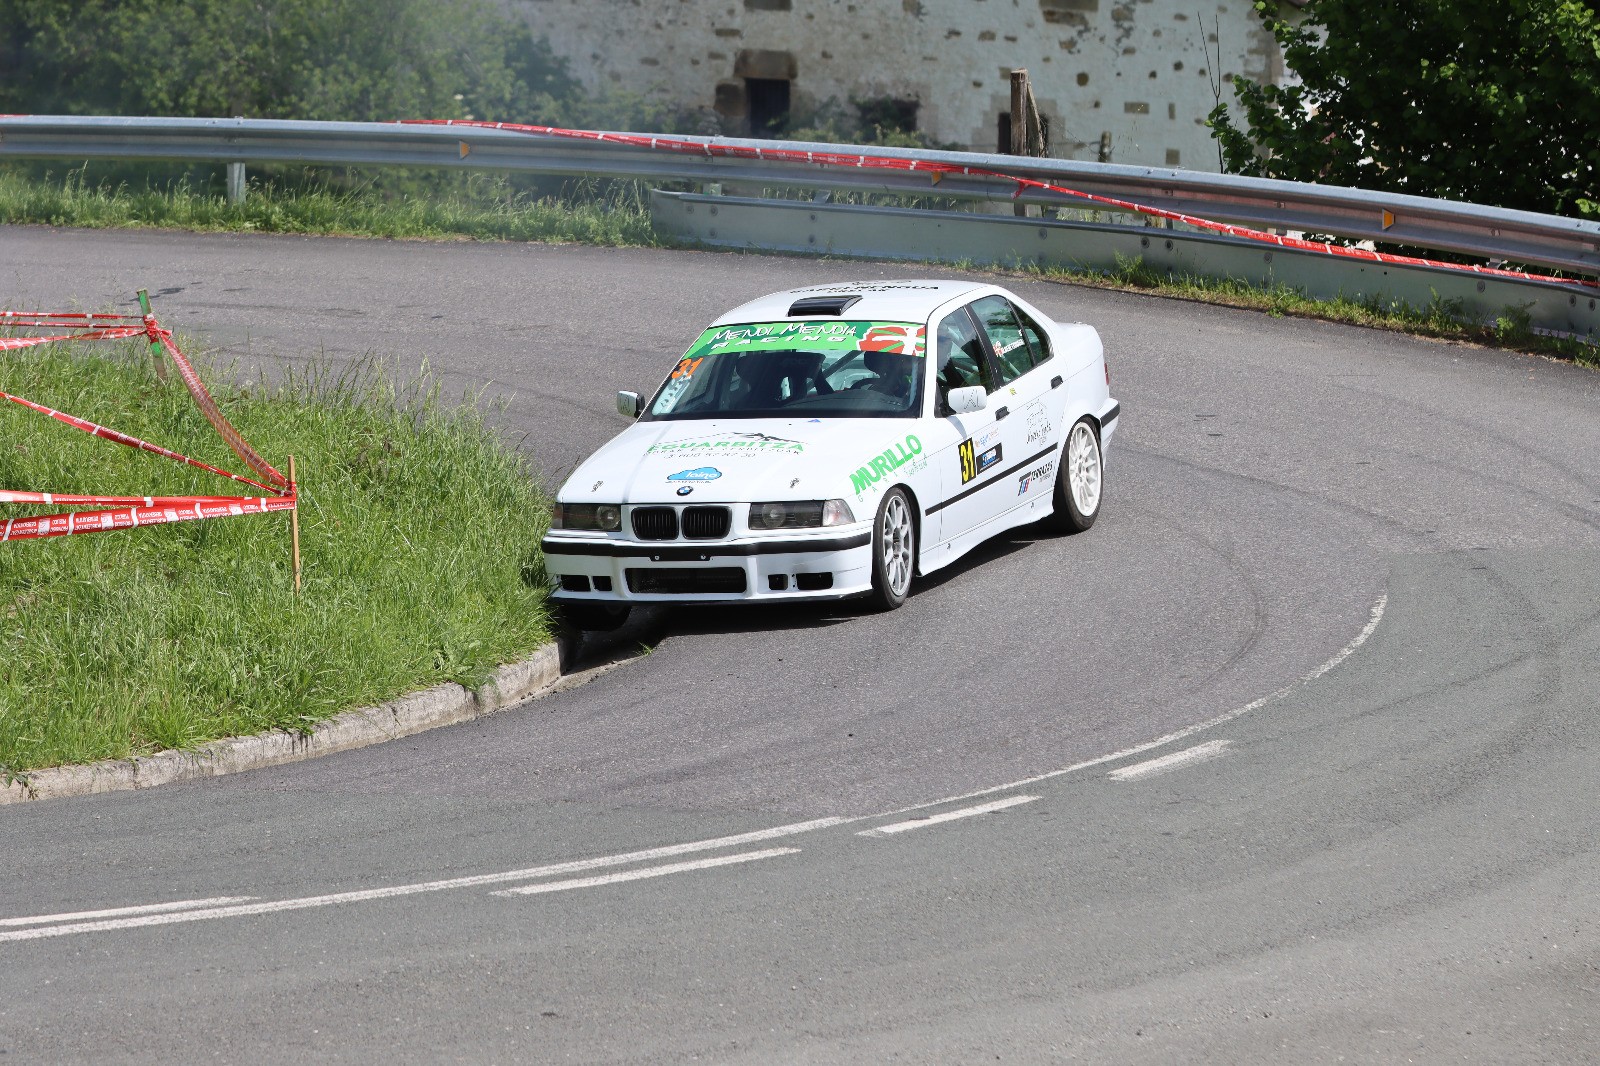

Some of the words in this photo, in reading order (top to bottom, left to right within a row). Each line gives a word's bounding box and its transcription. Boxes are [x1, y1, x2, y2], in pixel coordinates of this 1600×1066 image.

[707, 326, 774, 345] MENDI
[780, 323, 857, 337] MENDIA
[711, 336, 847, 349] RACING
[671, 357, 704, 379] 31
[646, 441, 804, 454] EGUARBITZA
[849, 434, 923, 495] MURILLO
[960, 440, 975, 482] 31
